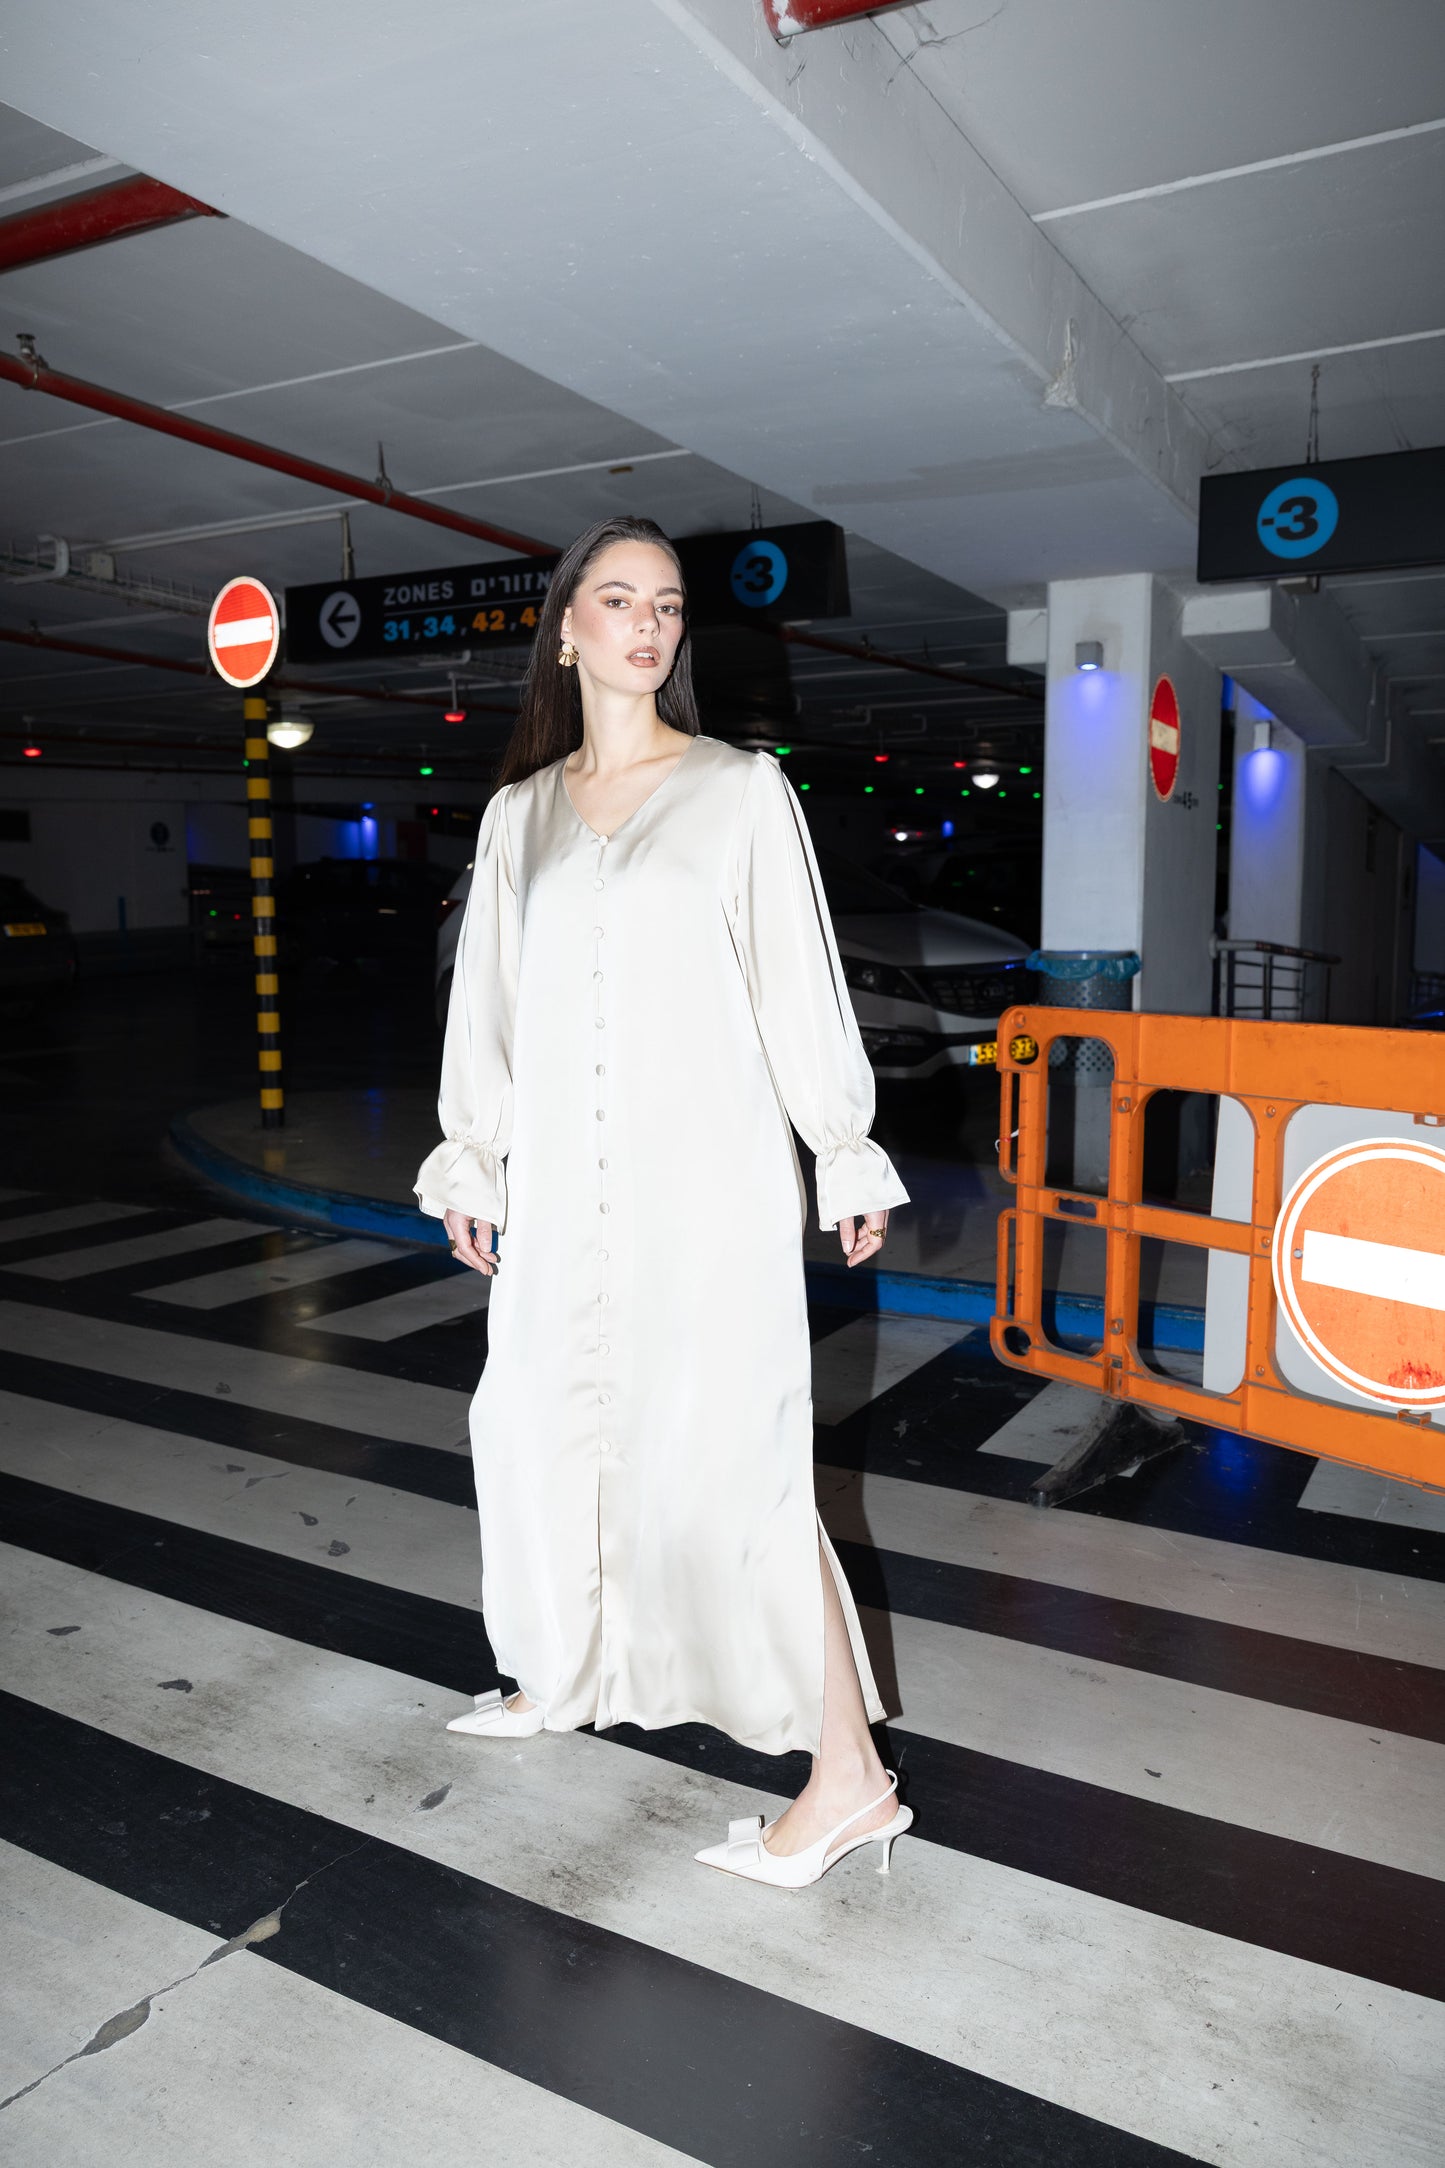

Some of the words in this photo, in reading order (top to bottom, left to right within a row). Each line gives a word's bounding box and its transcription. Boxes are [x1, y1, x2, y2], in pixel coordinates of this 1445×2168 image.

[1261, 496, 1319, 541] -3
[471, 574, 551, 596] אזורים
[734, 556, 775, 592] -3
[384, 581, 454, 605] ZONES
